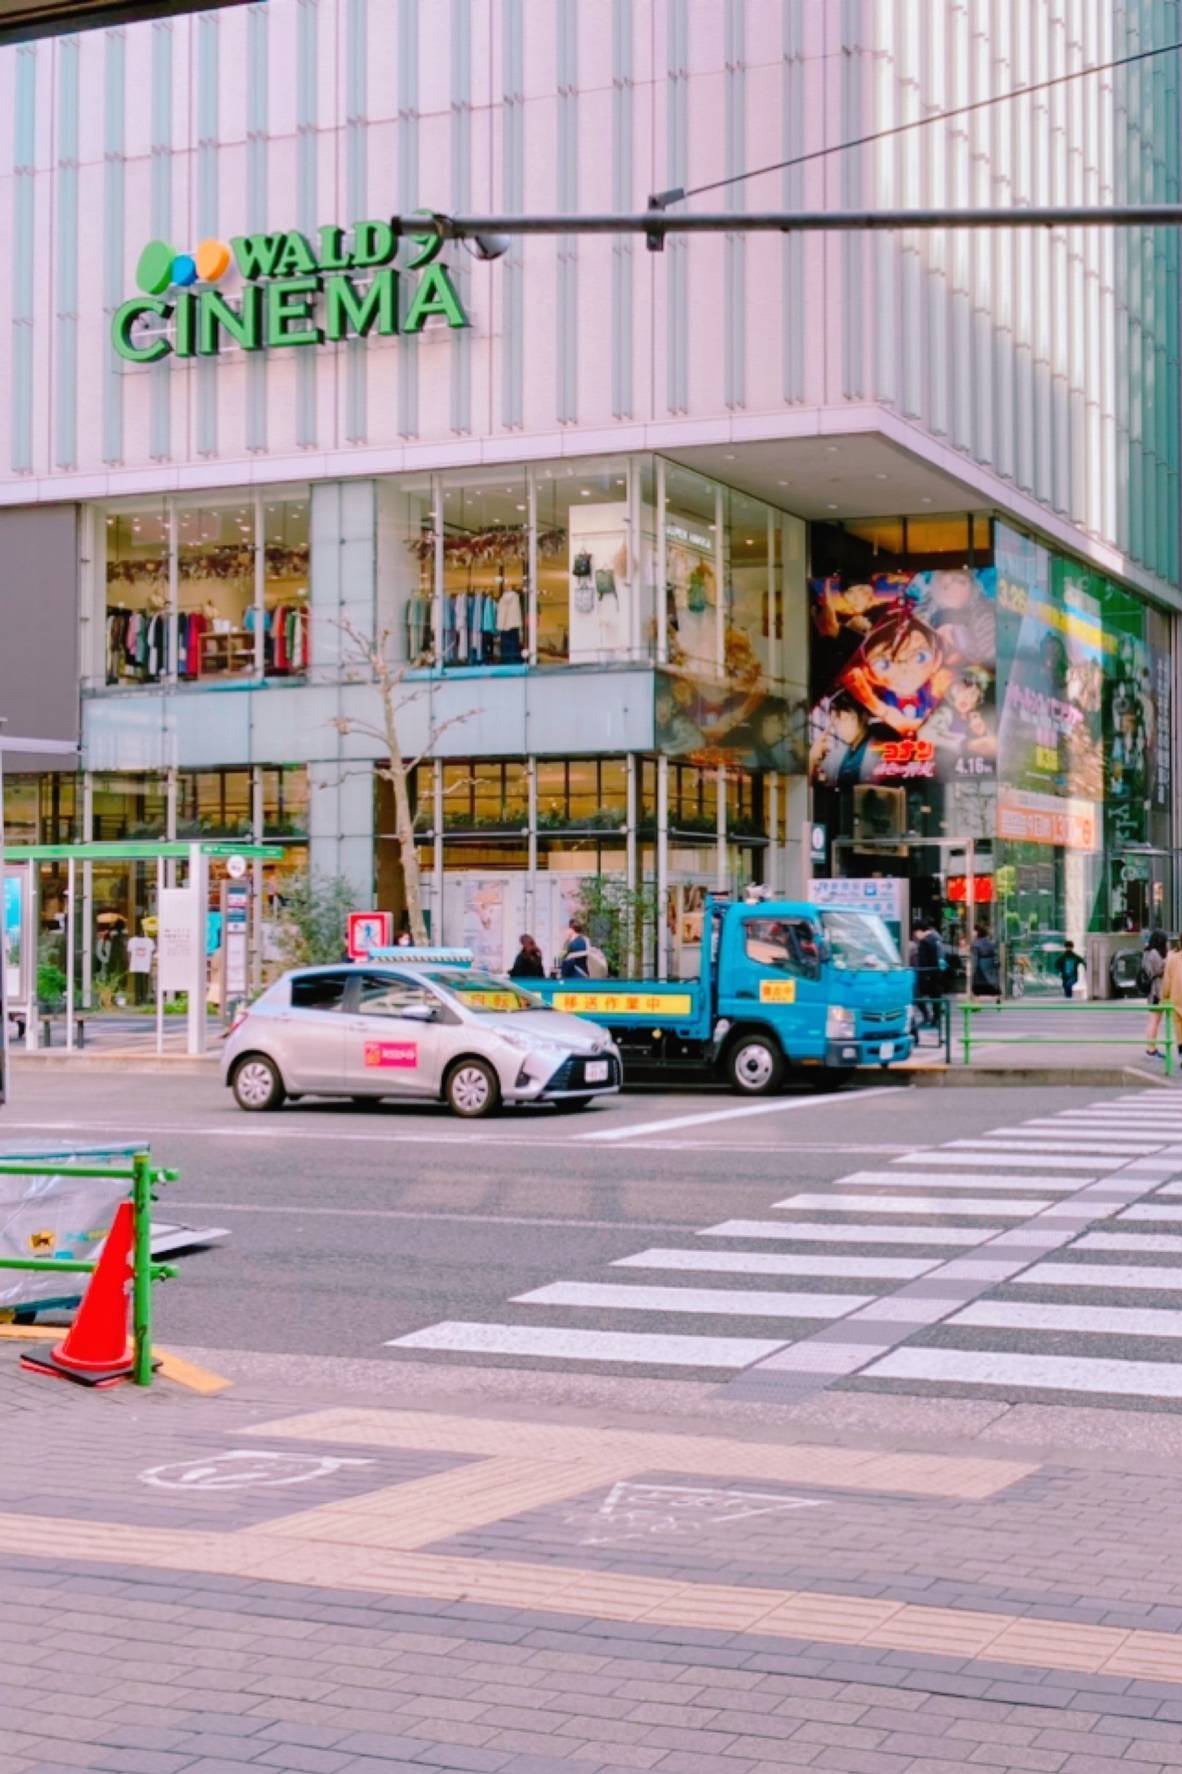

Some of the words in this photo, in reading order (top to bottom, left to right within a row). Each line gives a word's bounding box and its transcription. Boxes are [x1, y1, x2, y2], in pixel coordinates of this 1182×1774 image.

[231, 221, 396, 281] WALD
[111, 263, 470, 363] CINEMA
[955, 757, 985, 775] 4.16
